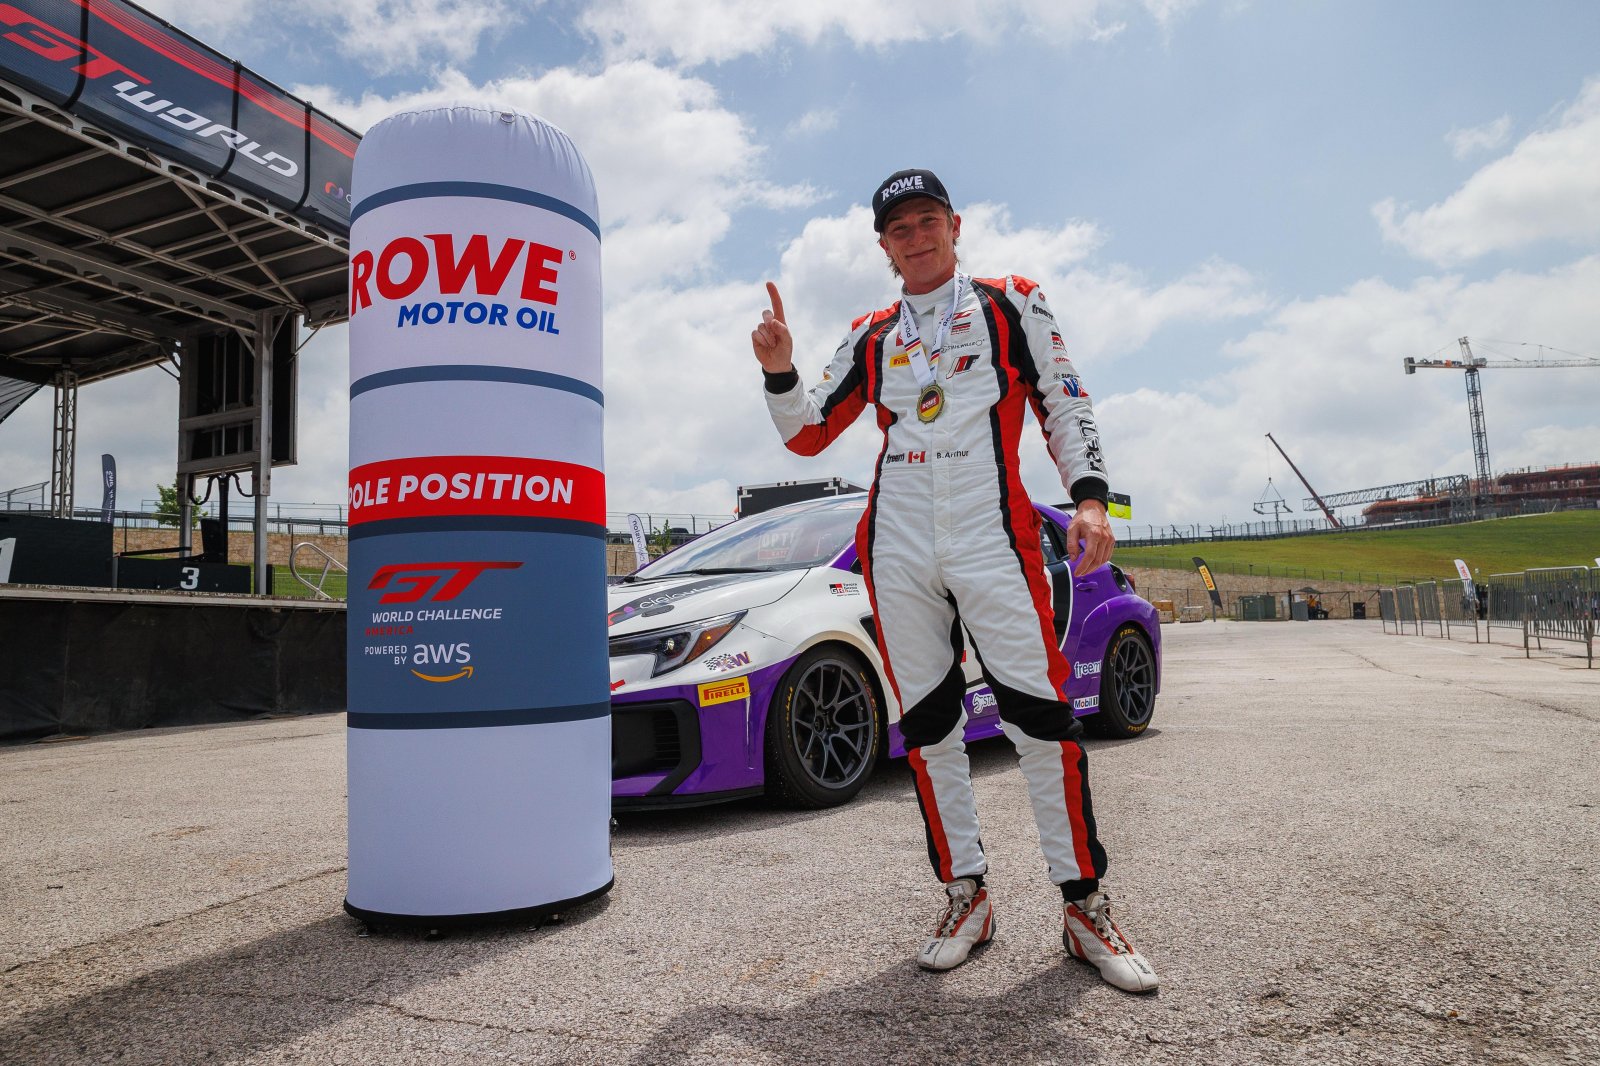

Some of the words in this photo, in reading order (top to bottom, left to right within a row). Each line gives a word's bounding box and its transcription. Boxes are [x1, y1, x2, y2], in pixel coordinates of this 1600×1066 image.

[0, 3, 151, 85] GT
[112, 80, 299, 178] WORLD
[881, 175, 923, 201] ROWE
[351, 233, 564, 317] ROWE
[397, 301, 509, 328] MOTOR
[515, 306, 560, 335] OIL
[893, 355, 910, 365] PIRE
[397, 472, 574, 504] POSITION
[180, 567, 200, 590] 3
[367, 561, 525, 604] GT
[372, 610, 414, 624] WORLD
[417, 608, 503, 621] CHALLENGE
[365, 625, 414, 637] AMERICA
[364, 645, 408, 655] POWERED
[394, 655, 407, 665] BY
[413, 642, 471, 665] aws
[703, 682, 746, 700] PIRELLI
[983, 695, 997, 706] STA
[1074, 698, 1093, 708] Mobil
